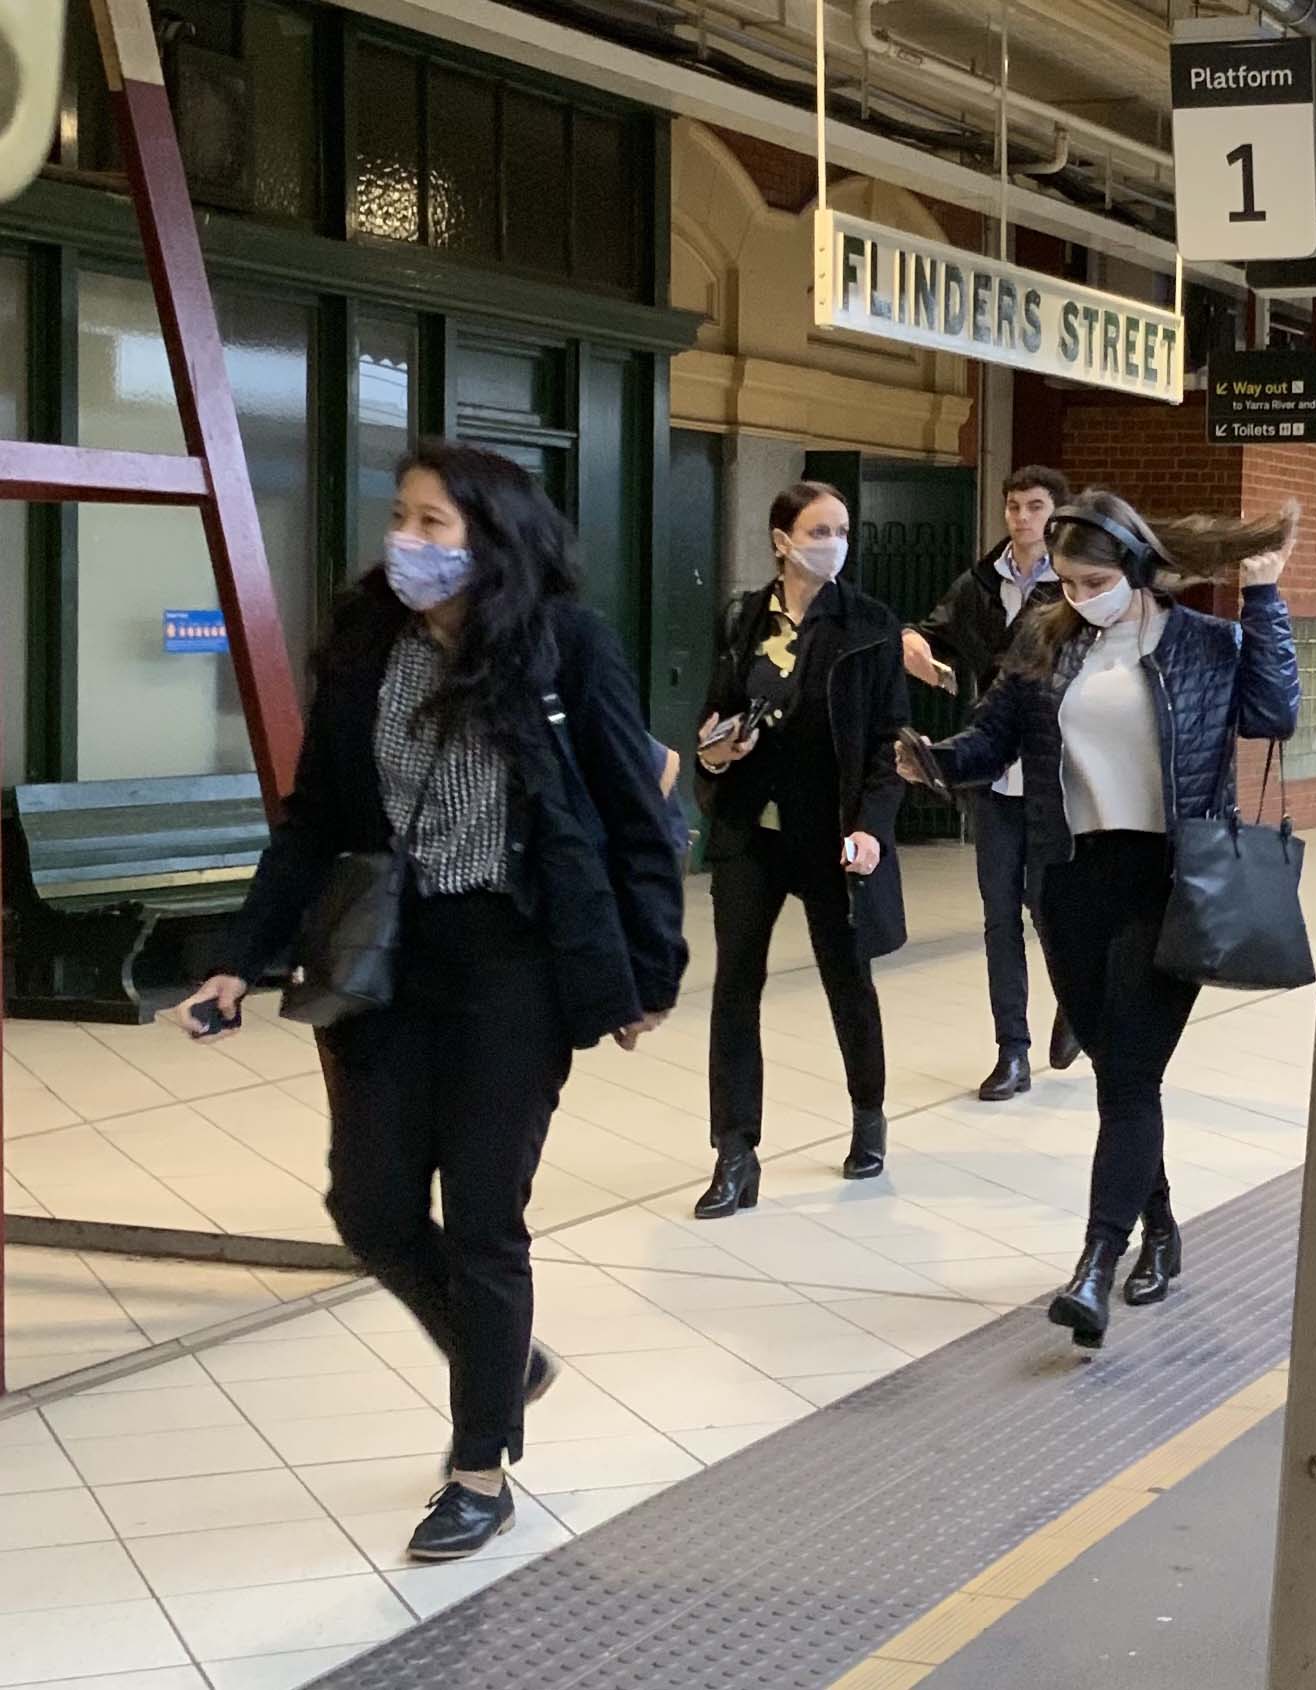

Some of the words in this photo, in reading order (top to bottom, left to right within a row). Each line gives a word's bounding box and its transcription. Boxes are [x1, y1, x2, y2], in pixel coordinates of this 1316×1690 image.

[1190, 65, 1293, 90] Platform
[1226, 143, 1267, 223] 1
[837, 231, 1042, 353] FLINDERS
[1060, 299, 1177, 386] STREET
[1232, 380, 1261, 397] Way
[1265, 381, 1288, 395] out
[1232, 401, 1243, 411] to
[1245, 400, 1270, 411] Yarra
[1271, 400, 1295, 410] River
[1298, 400, 1316, 410] and
[1232, 422, 1276, 437] Toilets
